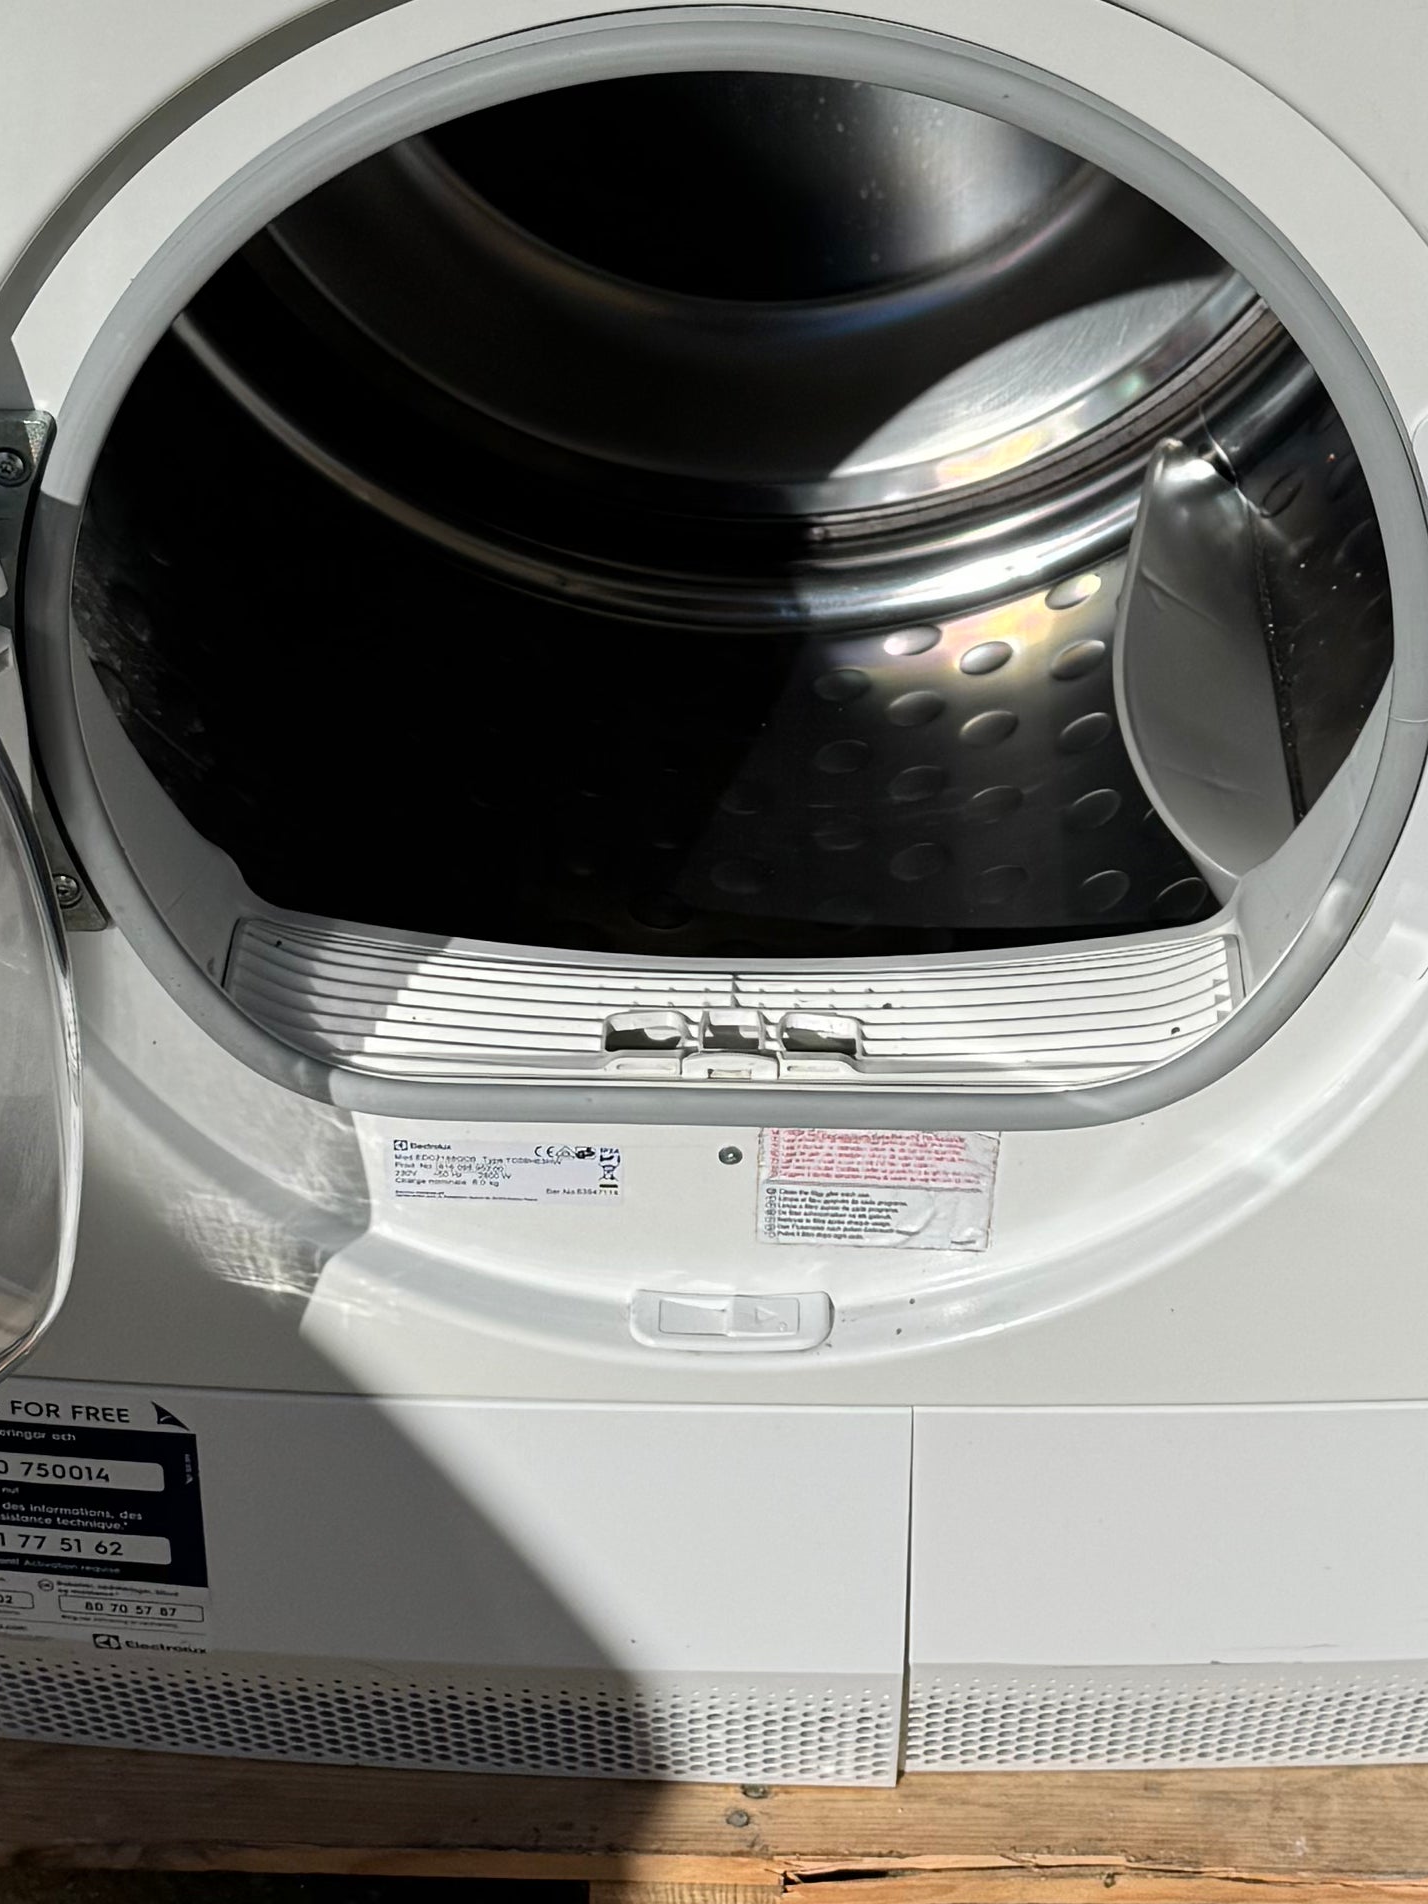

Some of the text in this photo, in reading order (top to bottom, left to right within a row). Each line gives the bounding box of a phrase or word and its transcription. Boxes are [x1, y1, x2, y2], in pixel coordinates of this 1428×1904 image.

[11, 1400, 61, 1419] FOR
[71, 1404, 131, 1423] FREE
[20, 1461, 111, 1483] 750014
[1, 1501, 26, 1512] des
[29, 1503, 112, 1520] informations,
[119, 1510, 143, 1521] des
[18, 1533, 48, 1550] 77
[59, 1537, 83, 1554] 51
[94, 1540, 124, 1556] 62
[85, 1601, 177, 1617] 80 70 57 87
[125, 1640, 207, 1654] Electrolux
